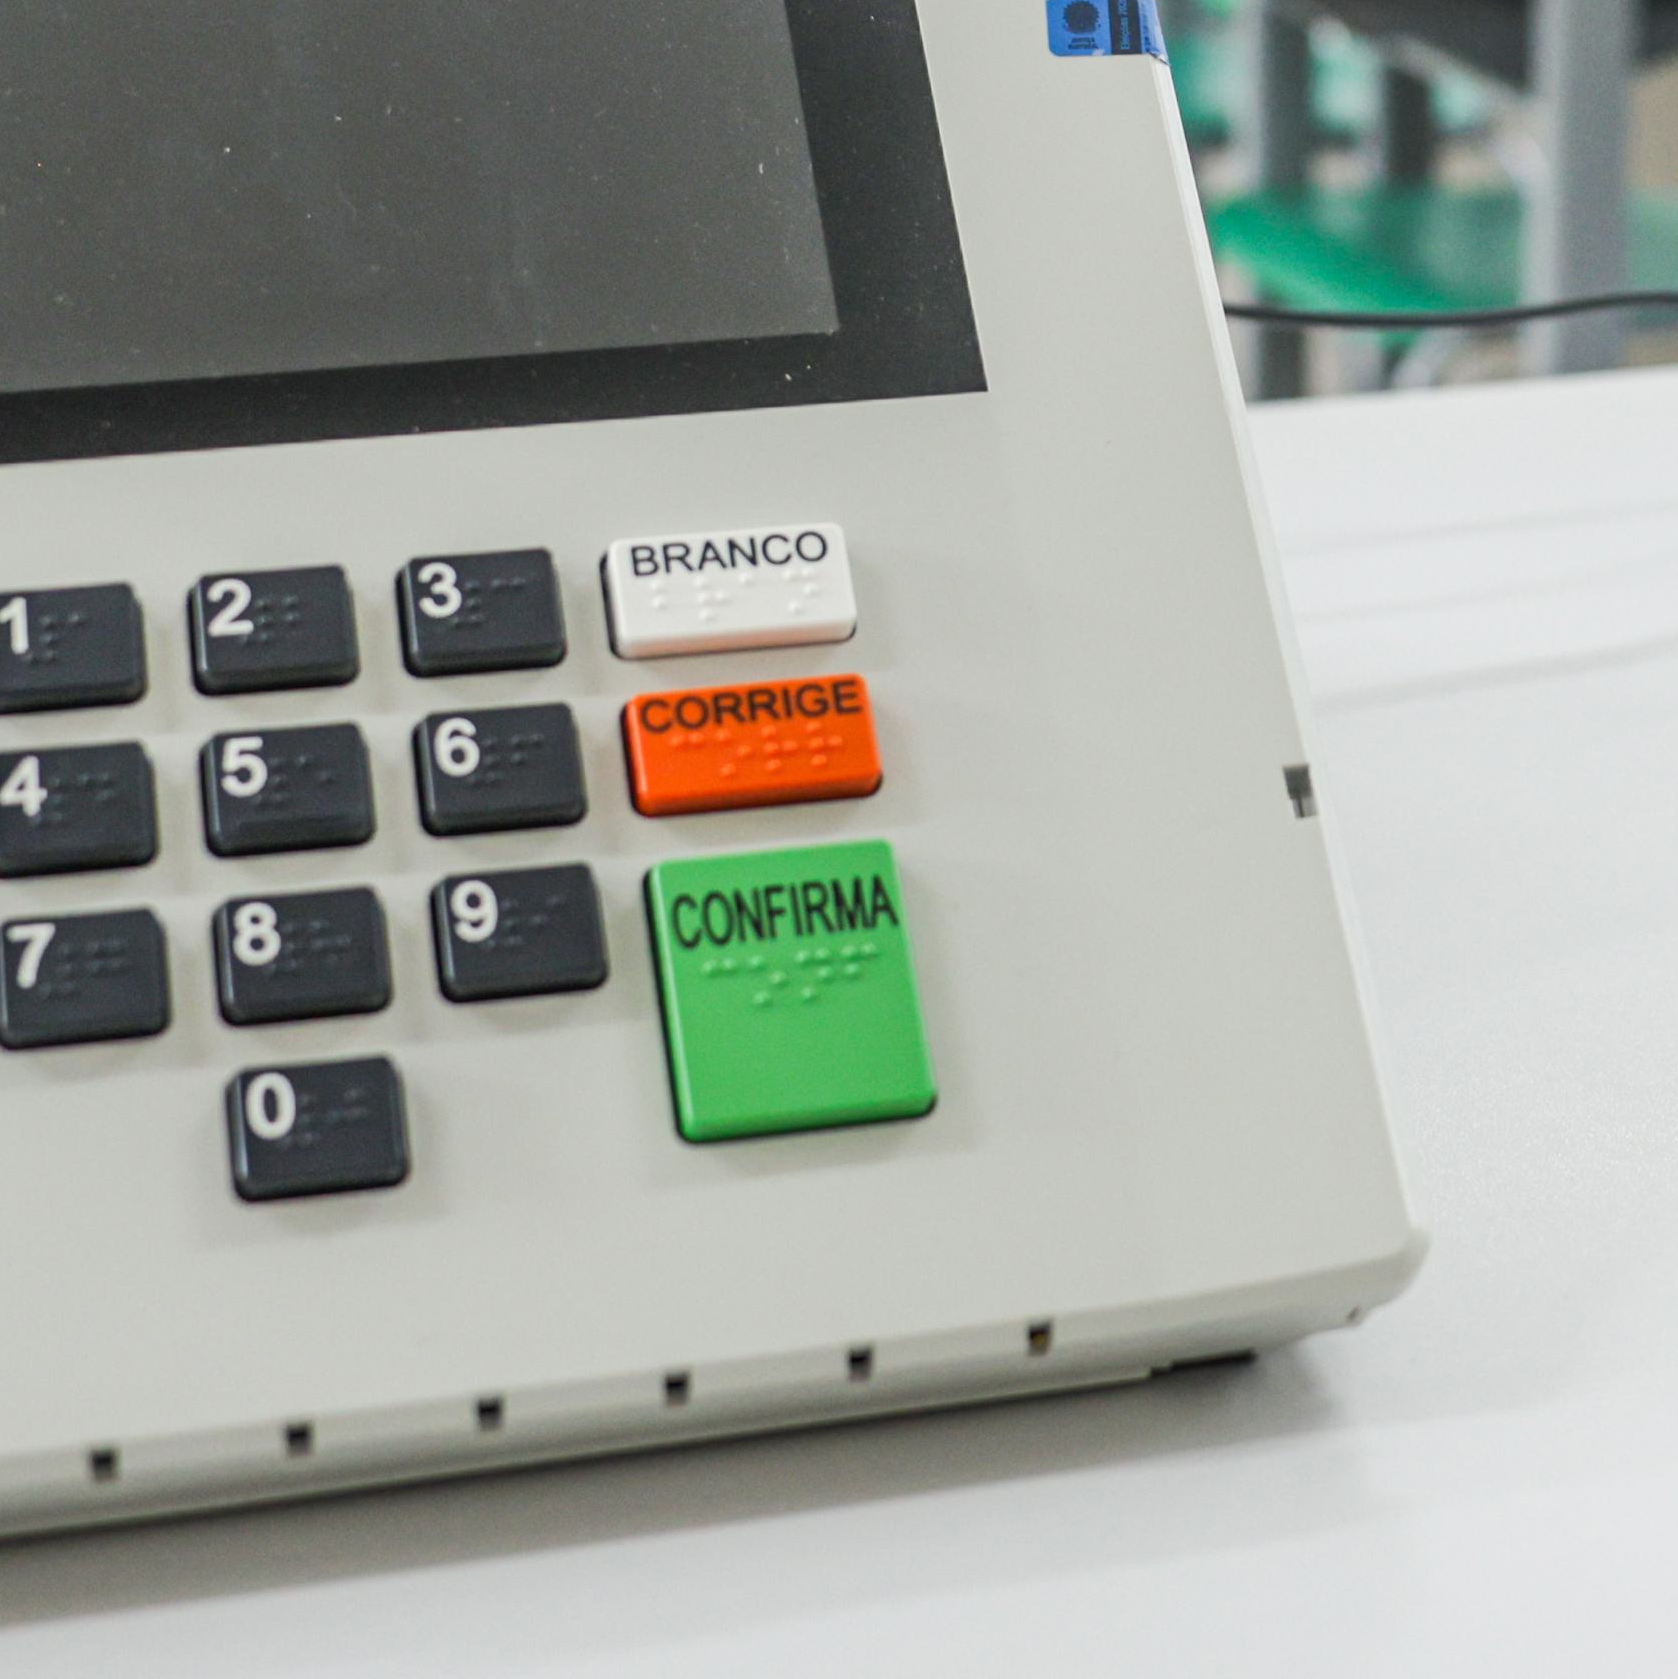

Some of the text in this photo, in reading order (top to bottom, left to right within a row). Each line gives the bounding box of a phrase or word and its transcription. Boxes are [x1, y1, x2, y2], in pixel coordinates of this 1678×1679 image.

[630, 530, 828, 578] BRANCO
[206, 579, 253, 637] 2
[418, 563, 462, 618] 3
[640, 680, 862, 733] CORRIGE
[221, 737, 268, 796] 5
[433, 719, 479, 777] 6
[0, 756, 47, 816] 4
[232, 902, 280, 965] 8
[450, 880, 497, 940] 9
[671, 873, 898, 950] CONFIRMA
[8, 923, 55, 988] 7
[244, 1072, 296, 1138] 0
